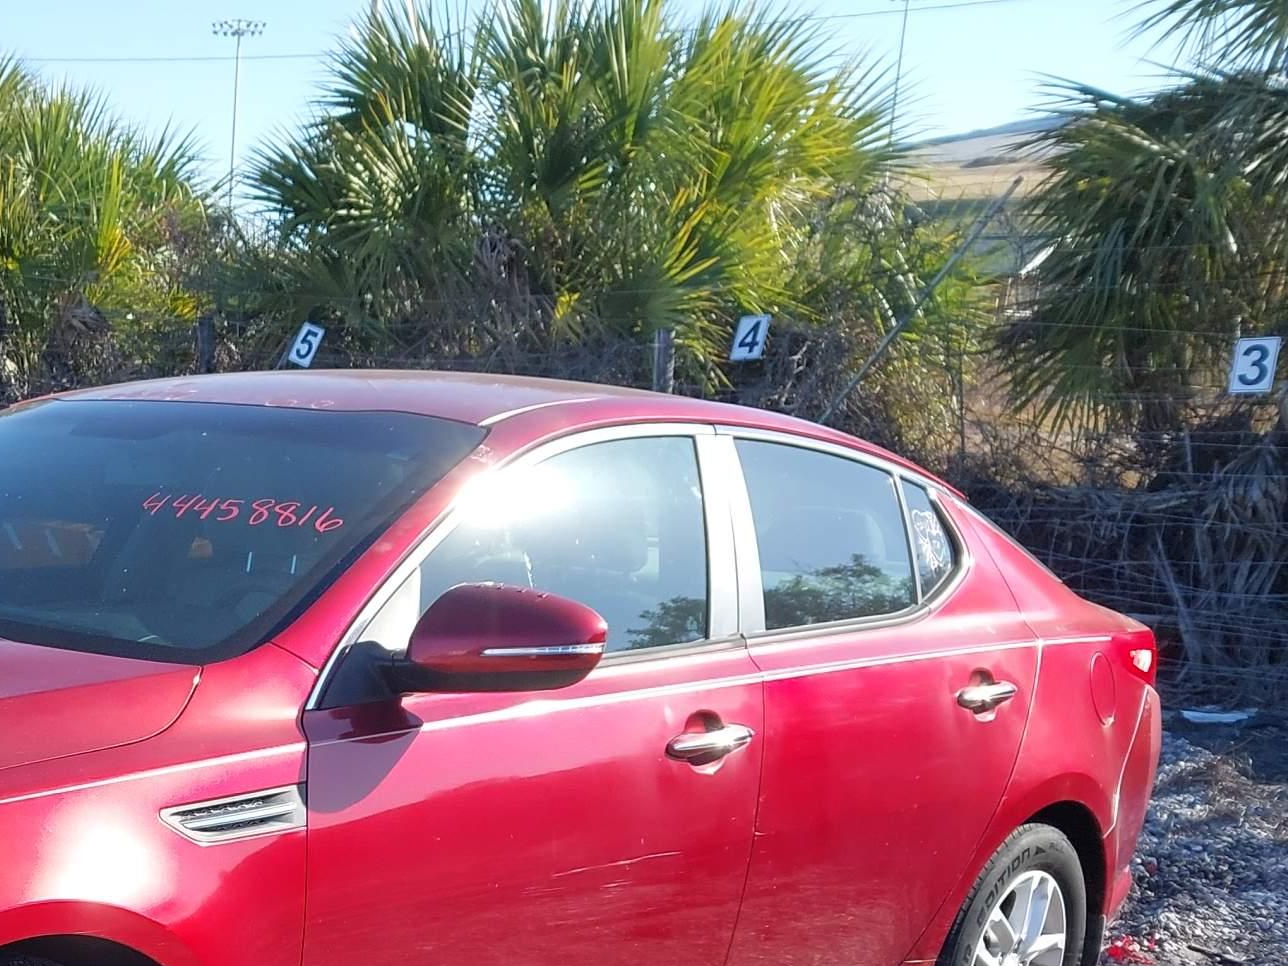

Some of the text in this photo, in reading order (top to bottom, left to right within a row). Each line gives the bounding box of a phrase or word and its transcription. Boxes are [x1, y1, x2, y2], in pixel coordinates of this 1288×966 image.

[295, 328, 319, 360] 5
[738, 319, 761, 354] 4
[1238, 343, 1269, 386] 3
[142, 492, 344, 533] 44458816
